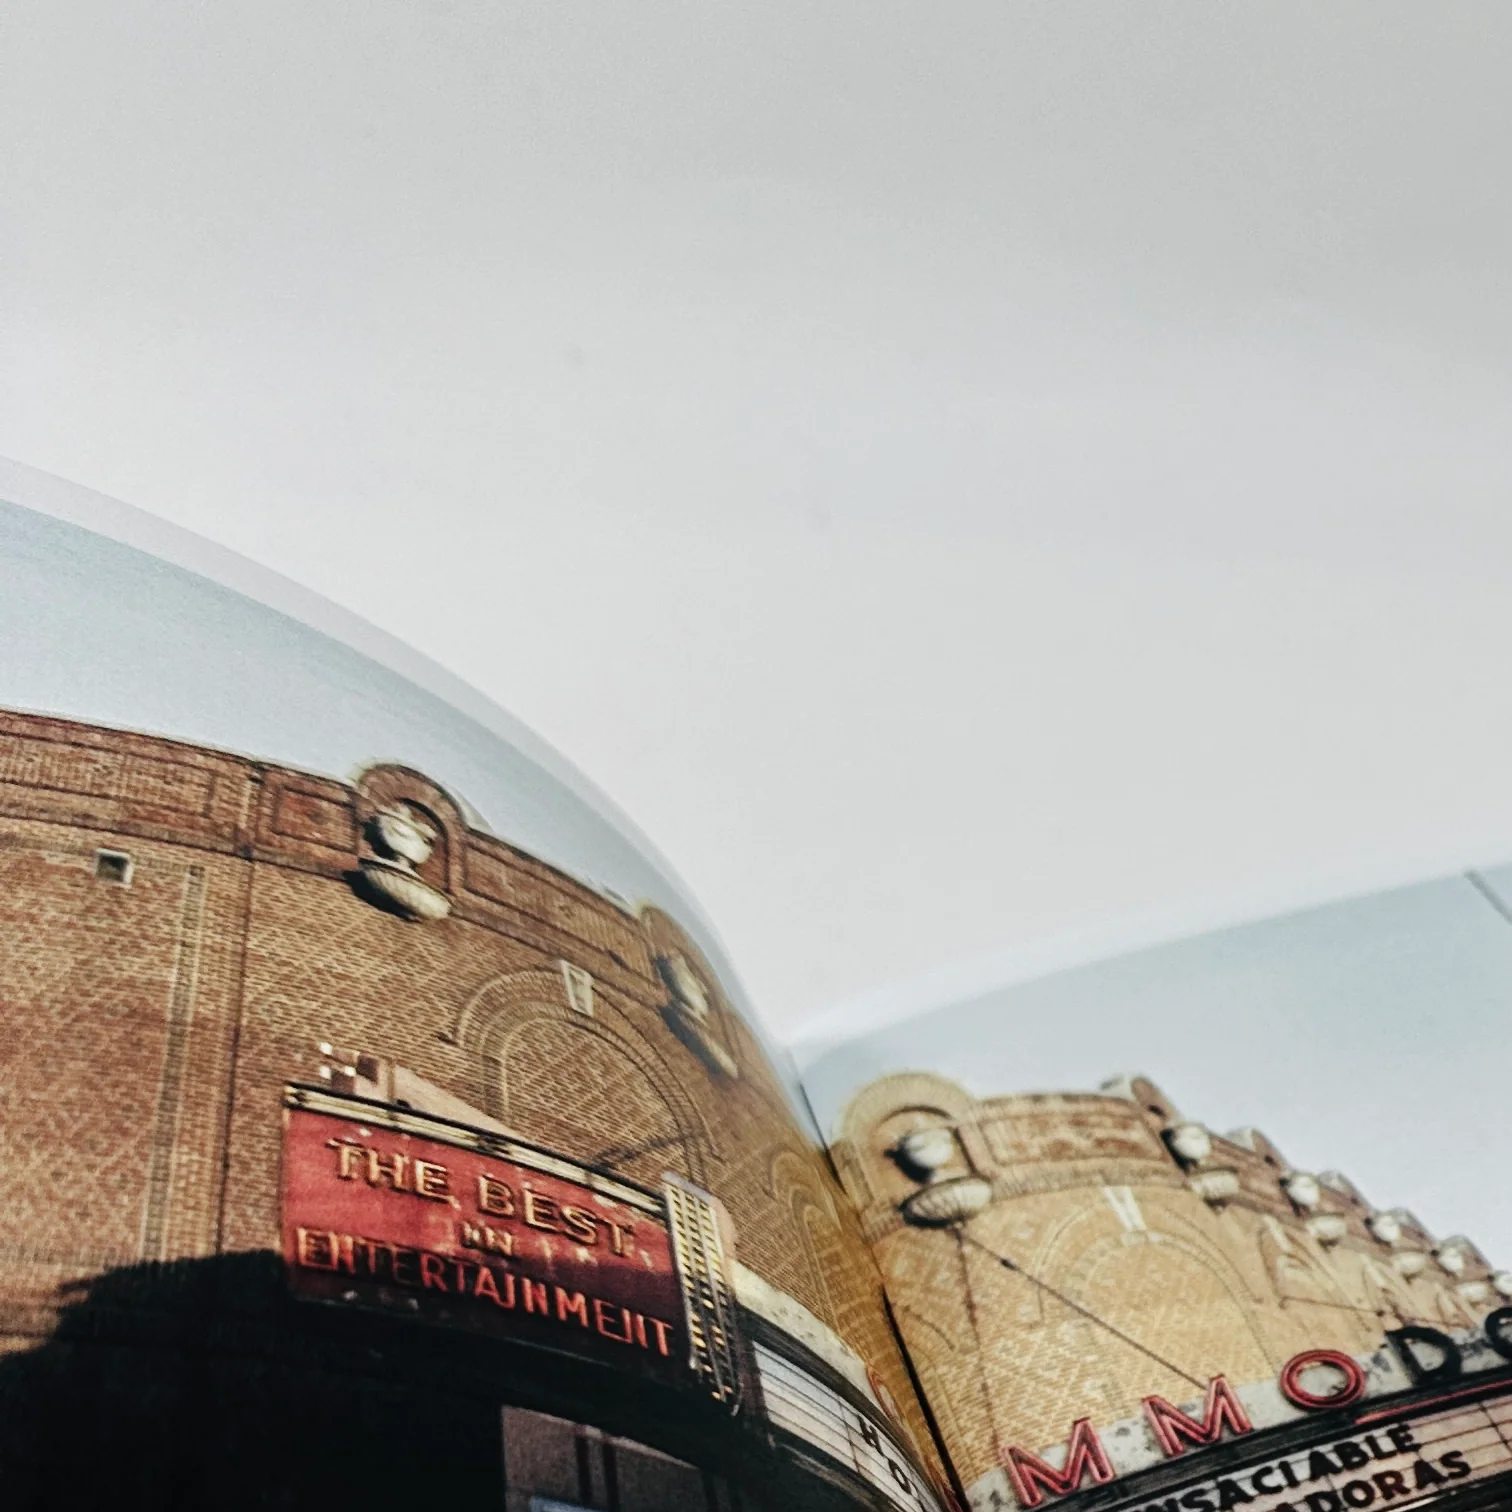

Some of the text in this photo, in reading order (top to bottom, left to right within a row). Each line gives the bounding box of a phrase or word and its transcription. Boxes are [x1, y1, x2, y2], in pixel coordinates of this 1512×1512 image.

[325, 1136, 633, 1257] THE BEST
[295, 1225, 675, 1358] ENTERTAINMENT
